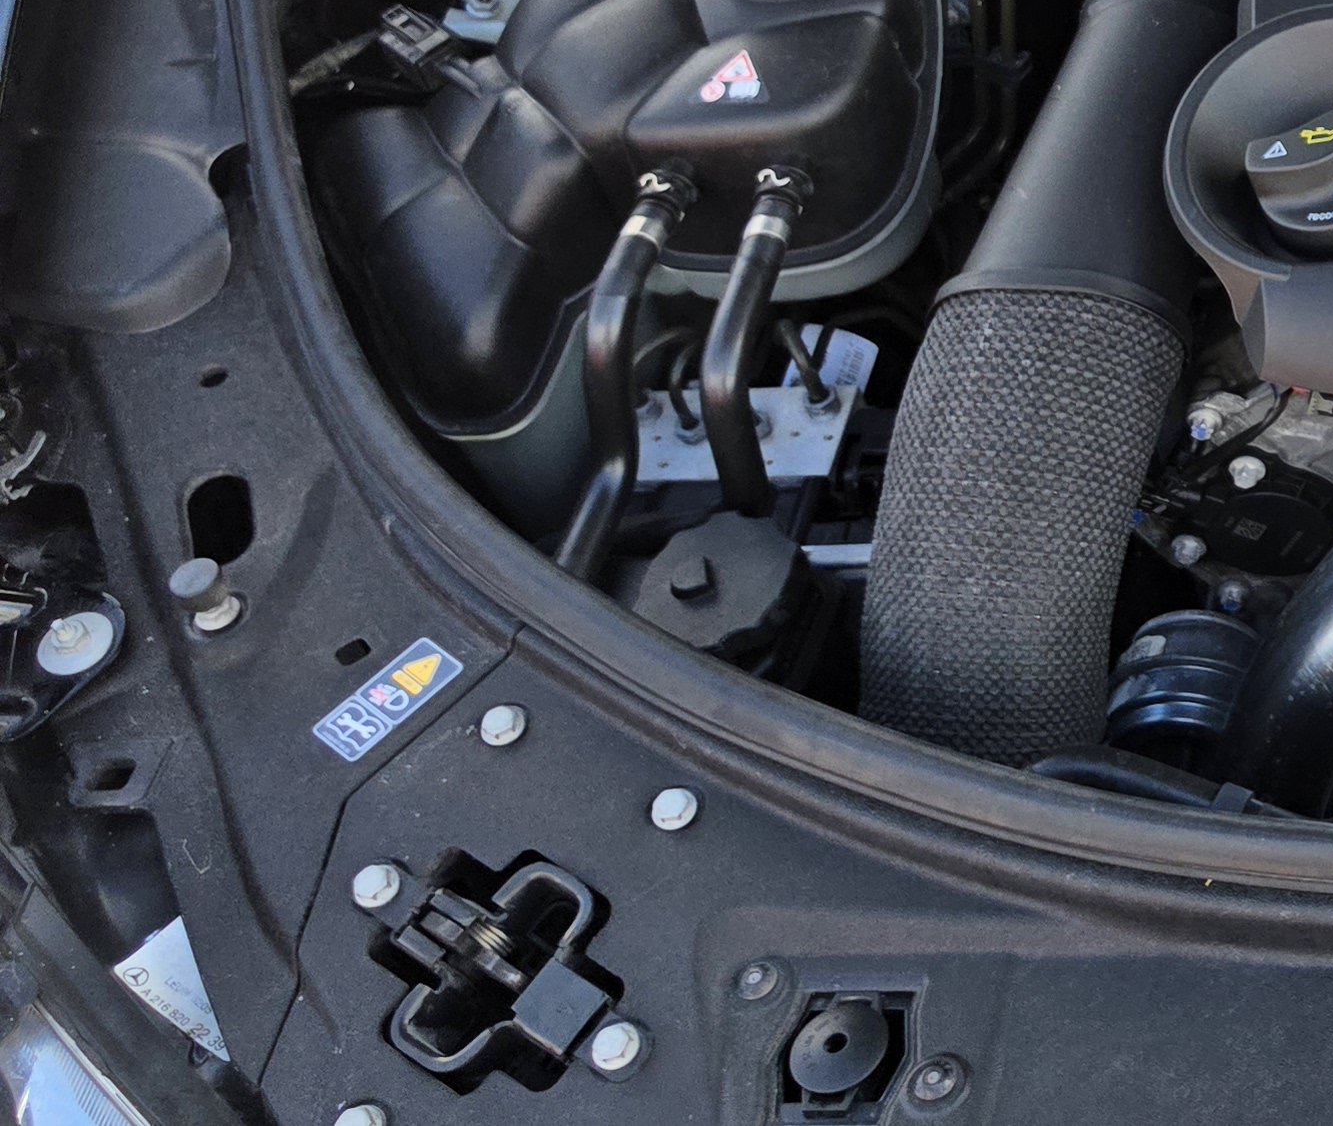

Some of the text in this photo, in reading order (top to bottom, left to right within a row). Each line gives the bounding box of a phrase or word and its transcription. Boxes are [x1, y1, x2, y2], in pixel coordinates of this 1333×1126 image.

[150, 995, 171, 1012] 216
[168, 1008, 191, 1027] 820
[190, 1023, 211, 1042] 22
[206, 1036, 226, 1052] 39
